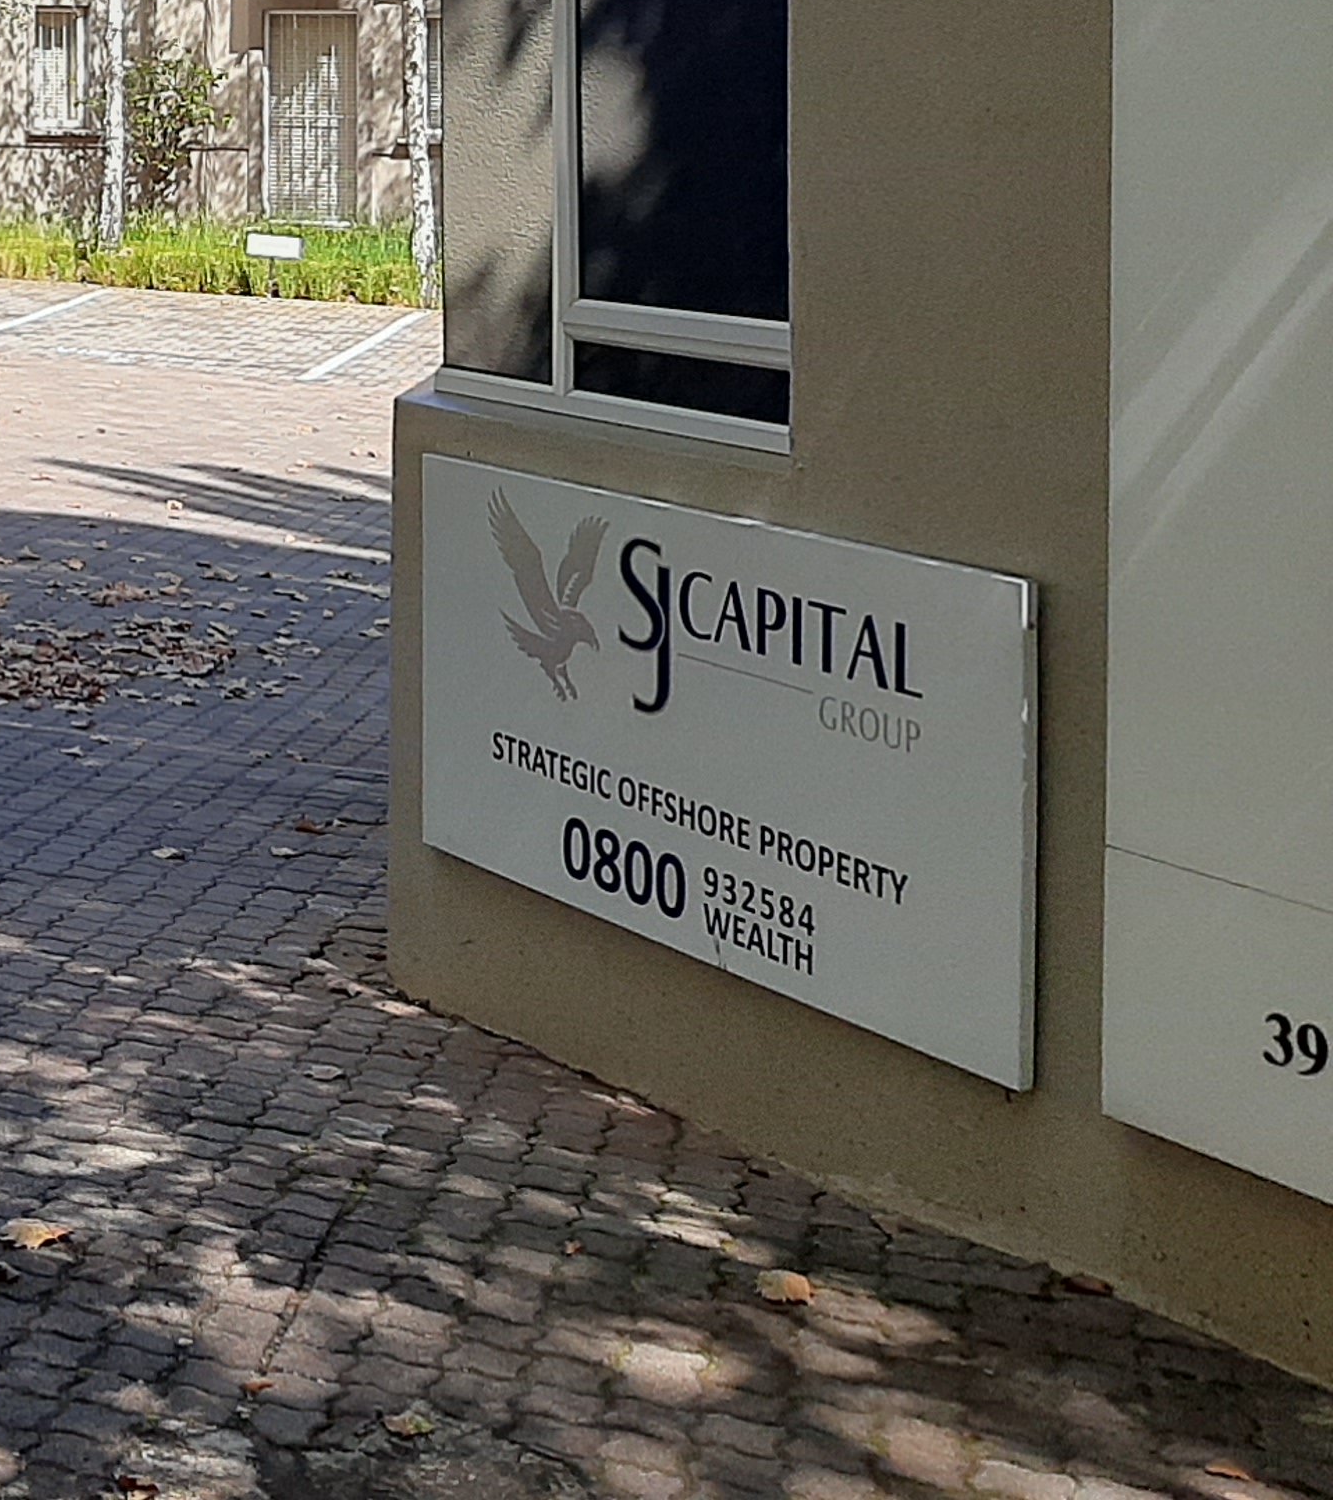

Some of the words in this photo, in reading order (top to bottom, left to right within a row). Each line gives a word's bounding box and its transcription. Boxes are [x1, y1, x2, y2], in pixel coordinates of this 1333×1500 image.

[679, 571, 923, 699] CAPITAL
[819, 696, 921, 752] GROUP
[492, 732, 611, 799] STRATEGIC
[618, 777, 751, 850] OFFSHORE
[760, 825, 909, 905] PROPERTY
[562, 816, 686, 918] 0800
[703, 867, 815, 936] 932584
[703, 903, 813, 975] WEALTH
[1263, 1013, 1328, 1076] 39
